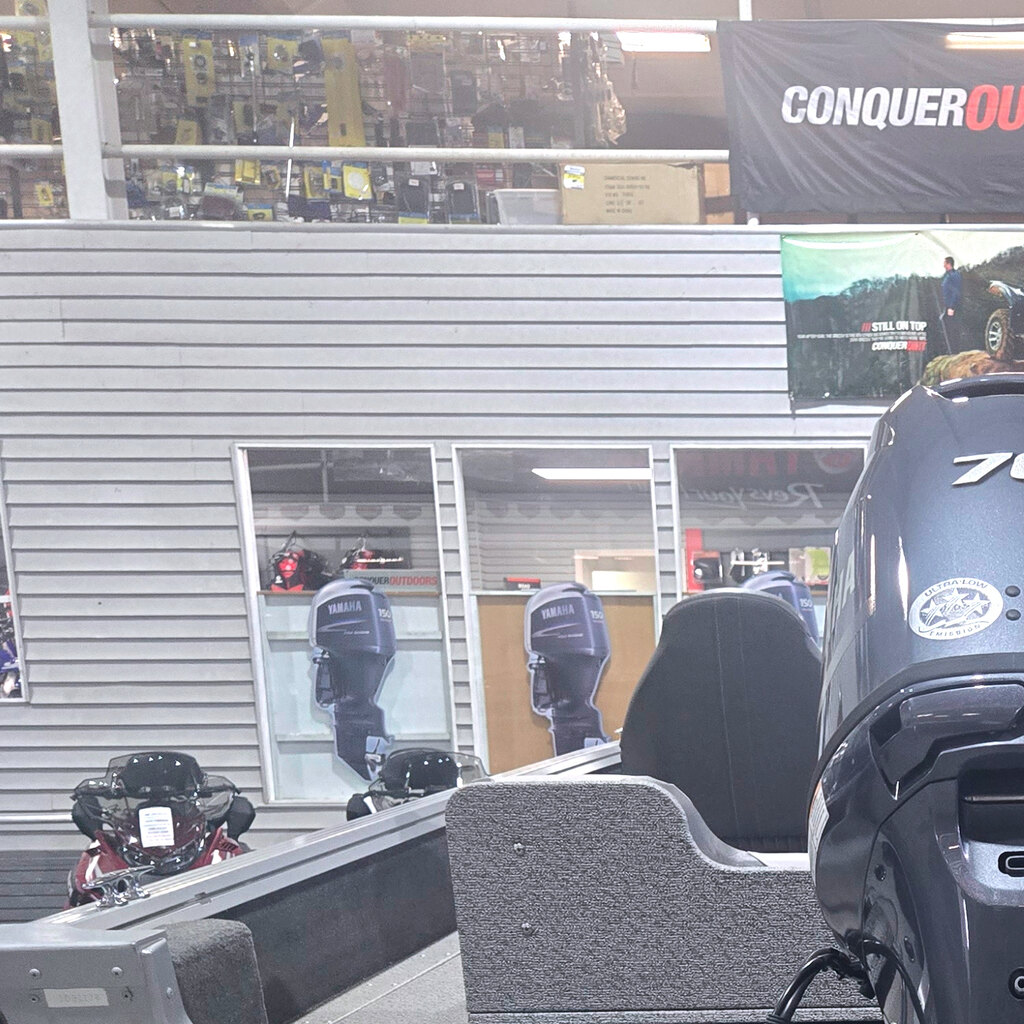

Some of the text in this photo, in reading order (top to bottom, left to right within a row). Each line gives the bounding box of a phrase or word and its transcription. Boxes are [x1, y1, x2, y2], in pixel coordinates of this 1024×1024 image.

[871, 320, 927, 332] STILL ON TOP
[328, 600, 362, 615] YAMAHA
[377, 607, 392, 619] 150
[541, 603, 575, 620] YAMAHA
[929, 621, 981, 637] EMISSION
